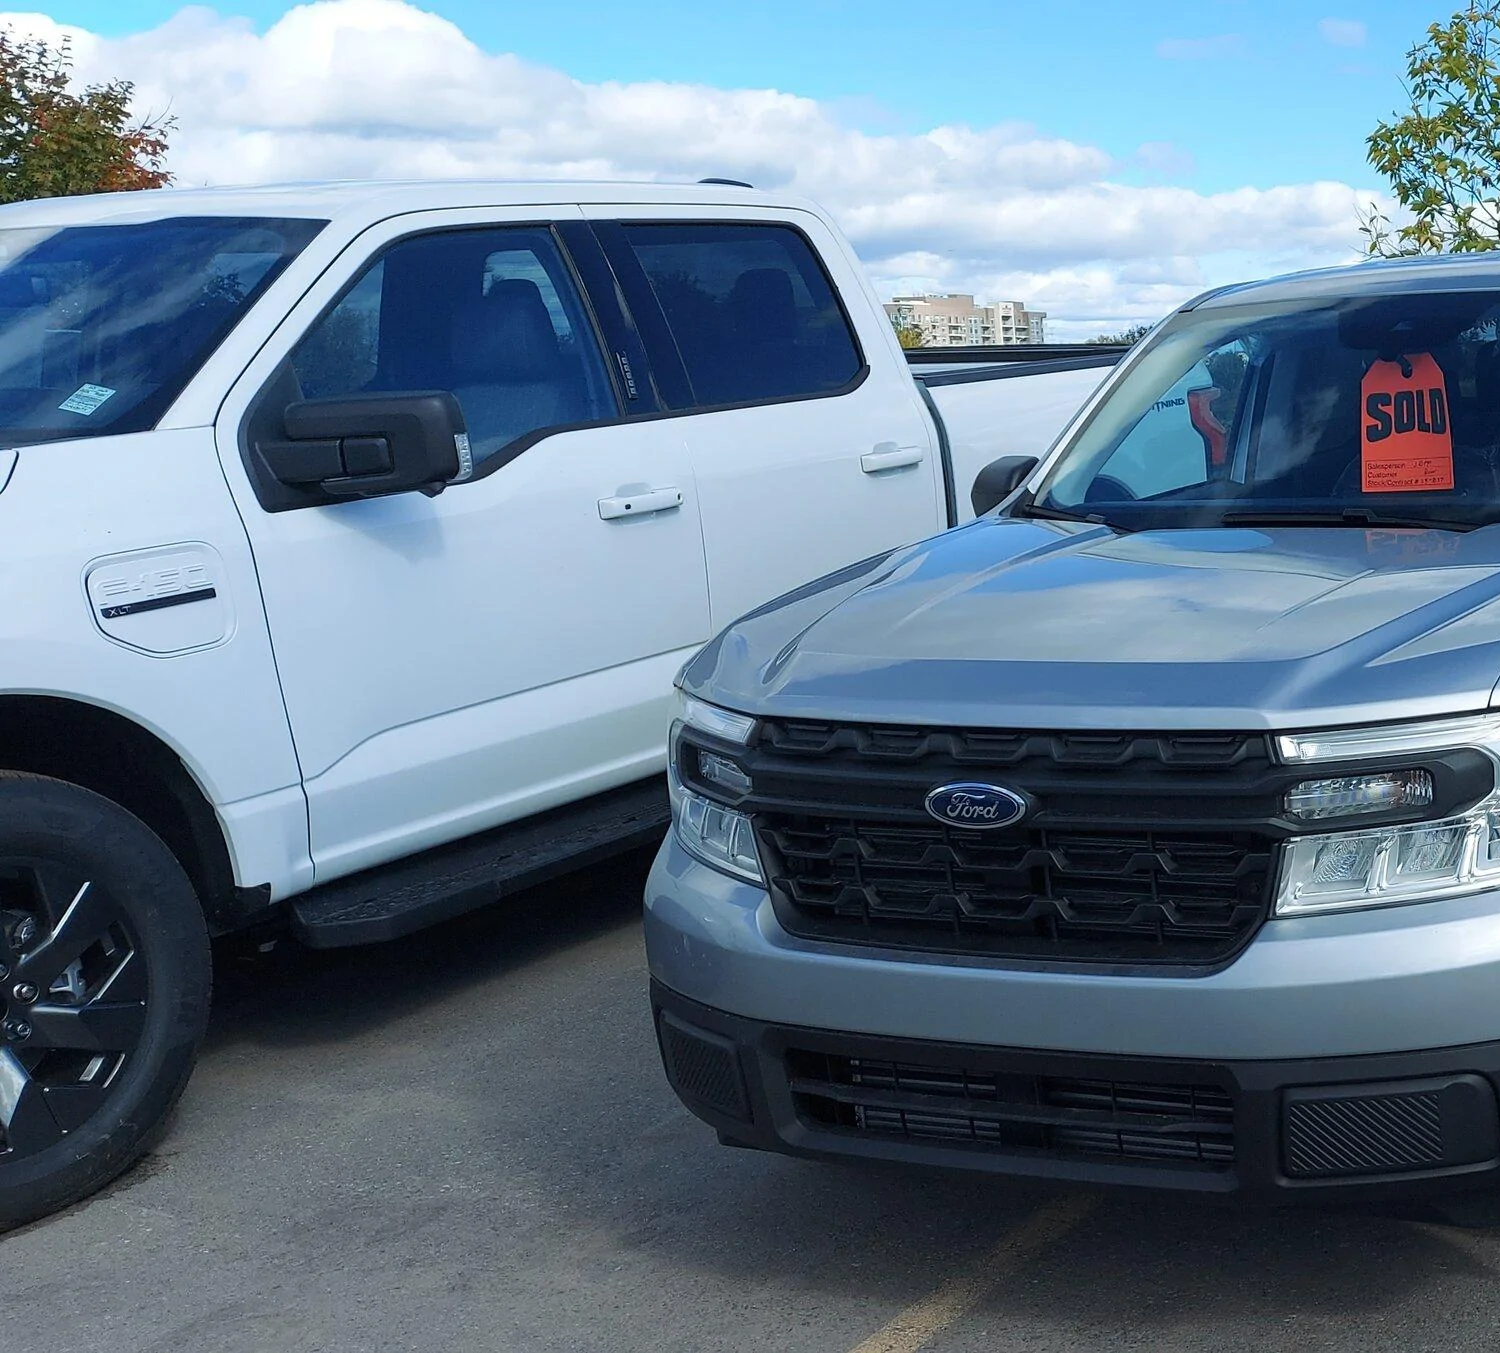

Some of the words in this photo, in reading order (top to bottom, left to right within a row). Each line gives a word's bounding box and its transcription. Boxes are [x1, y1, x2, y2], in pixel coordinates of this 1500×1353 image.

[1366, 388, 1447, 443] SOLD
[1367, 462, 1406, 471] Salesperson
[1367, 471, 1398, 479] Customer
[108, 604, 131, 617] XLT
[946, 792, 1000, 819] Ford
